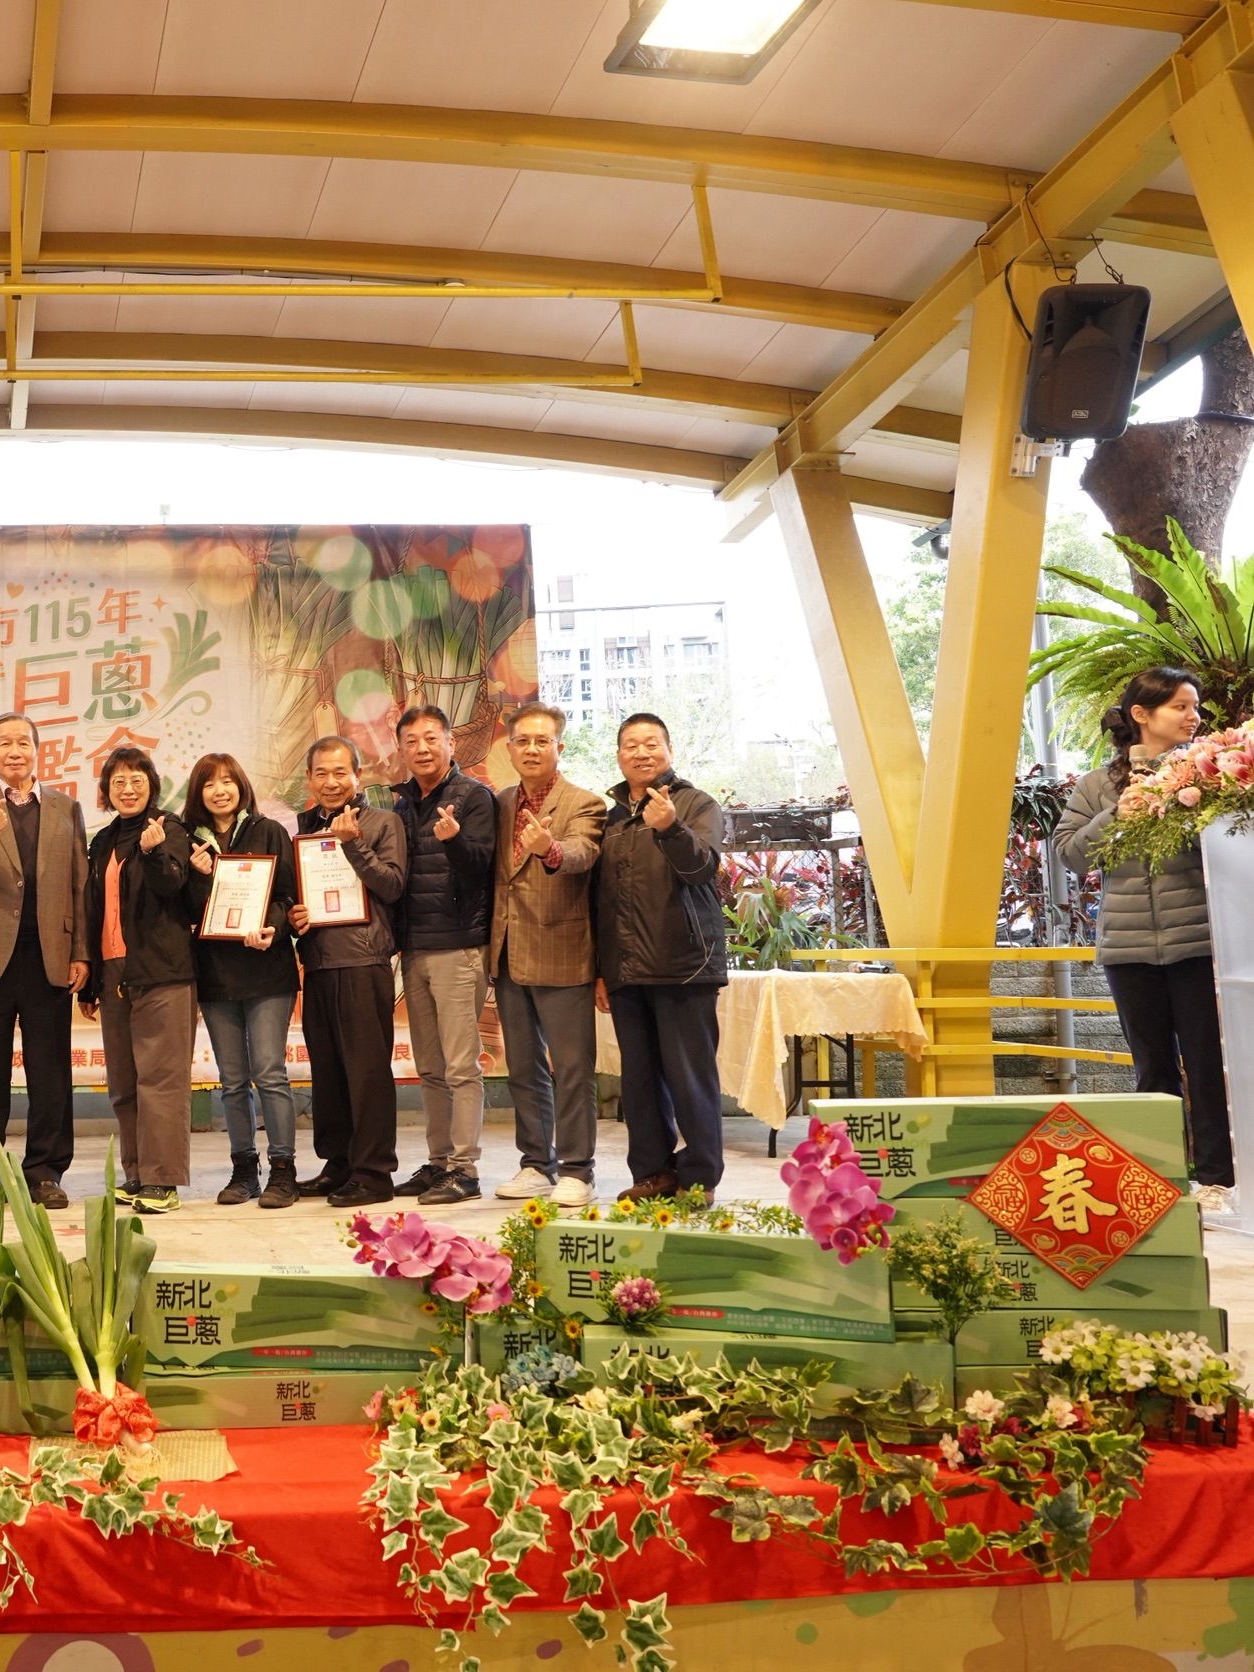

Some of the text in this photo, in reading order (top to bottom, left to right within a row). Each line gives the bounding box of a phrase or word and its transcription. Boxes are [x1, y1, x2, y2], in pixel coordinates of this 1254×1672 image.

[844, 1111, 904, 1144] 新北
[854, 1147, 917, 1178] 巨蔥
[1032, 1153, 1119, 1235] 春
[559, 1233, 616, 1265] 新北
[156, 1279, 212, 1311] 新北
[163, 1315, 221, 1345] 巨蔥
[1019, 1316, 1055, 1336] 新北
[1026, 1340, 1043, 1358] 巨
[276, 1380, 311, 1401] 新北
[281, 1402, 316, 1422] 巨蔥
